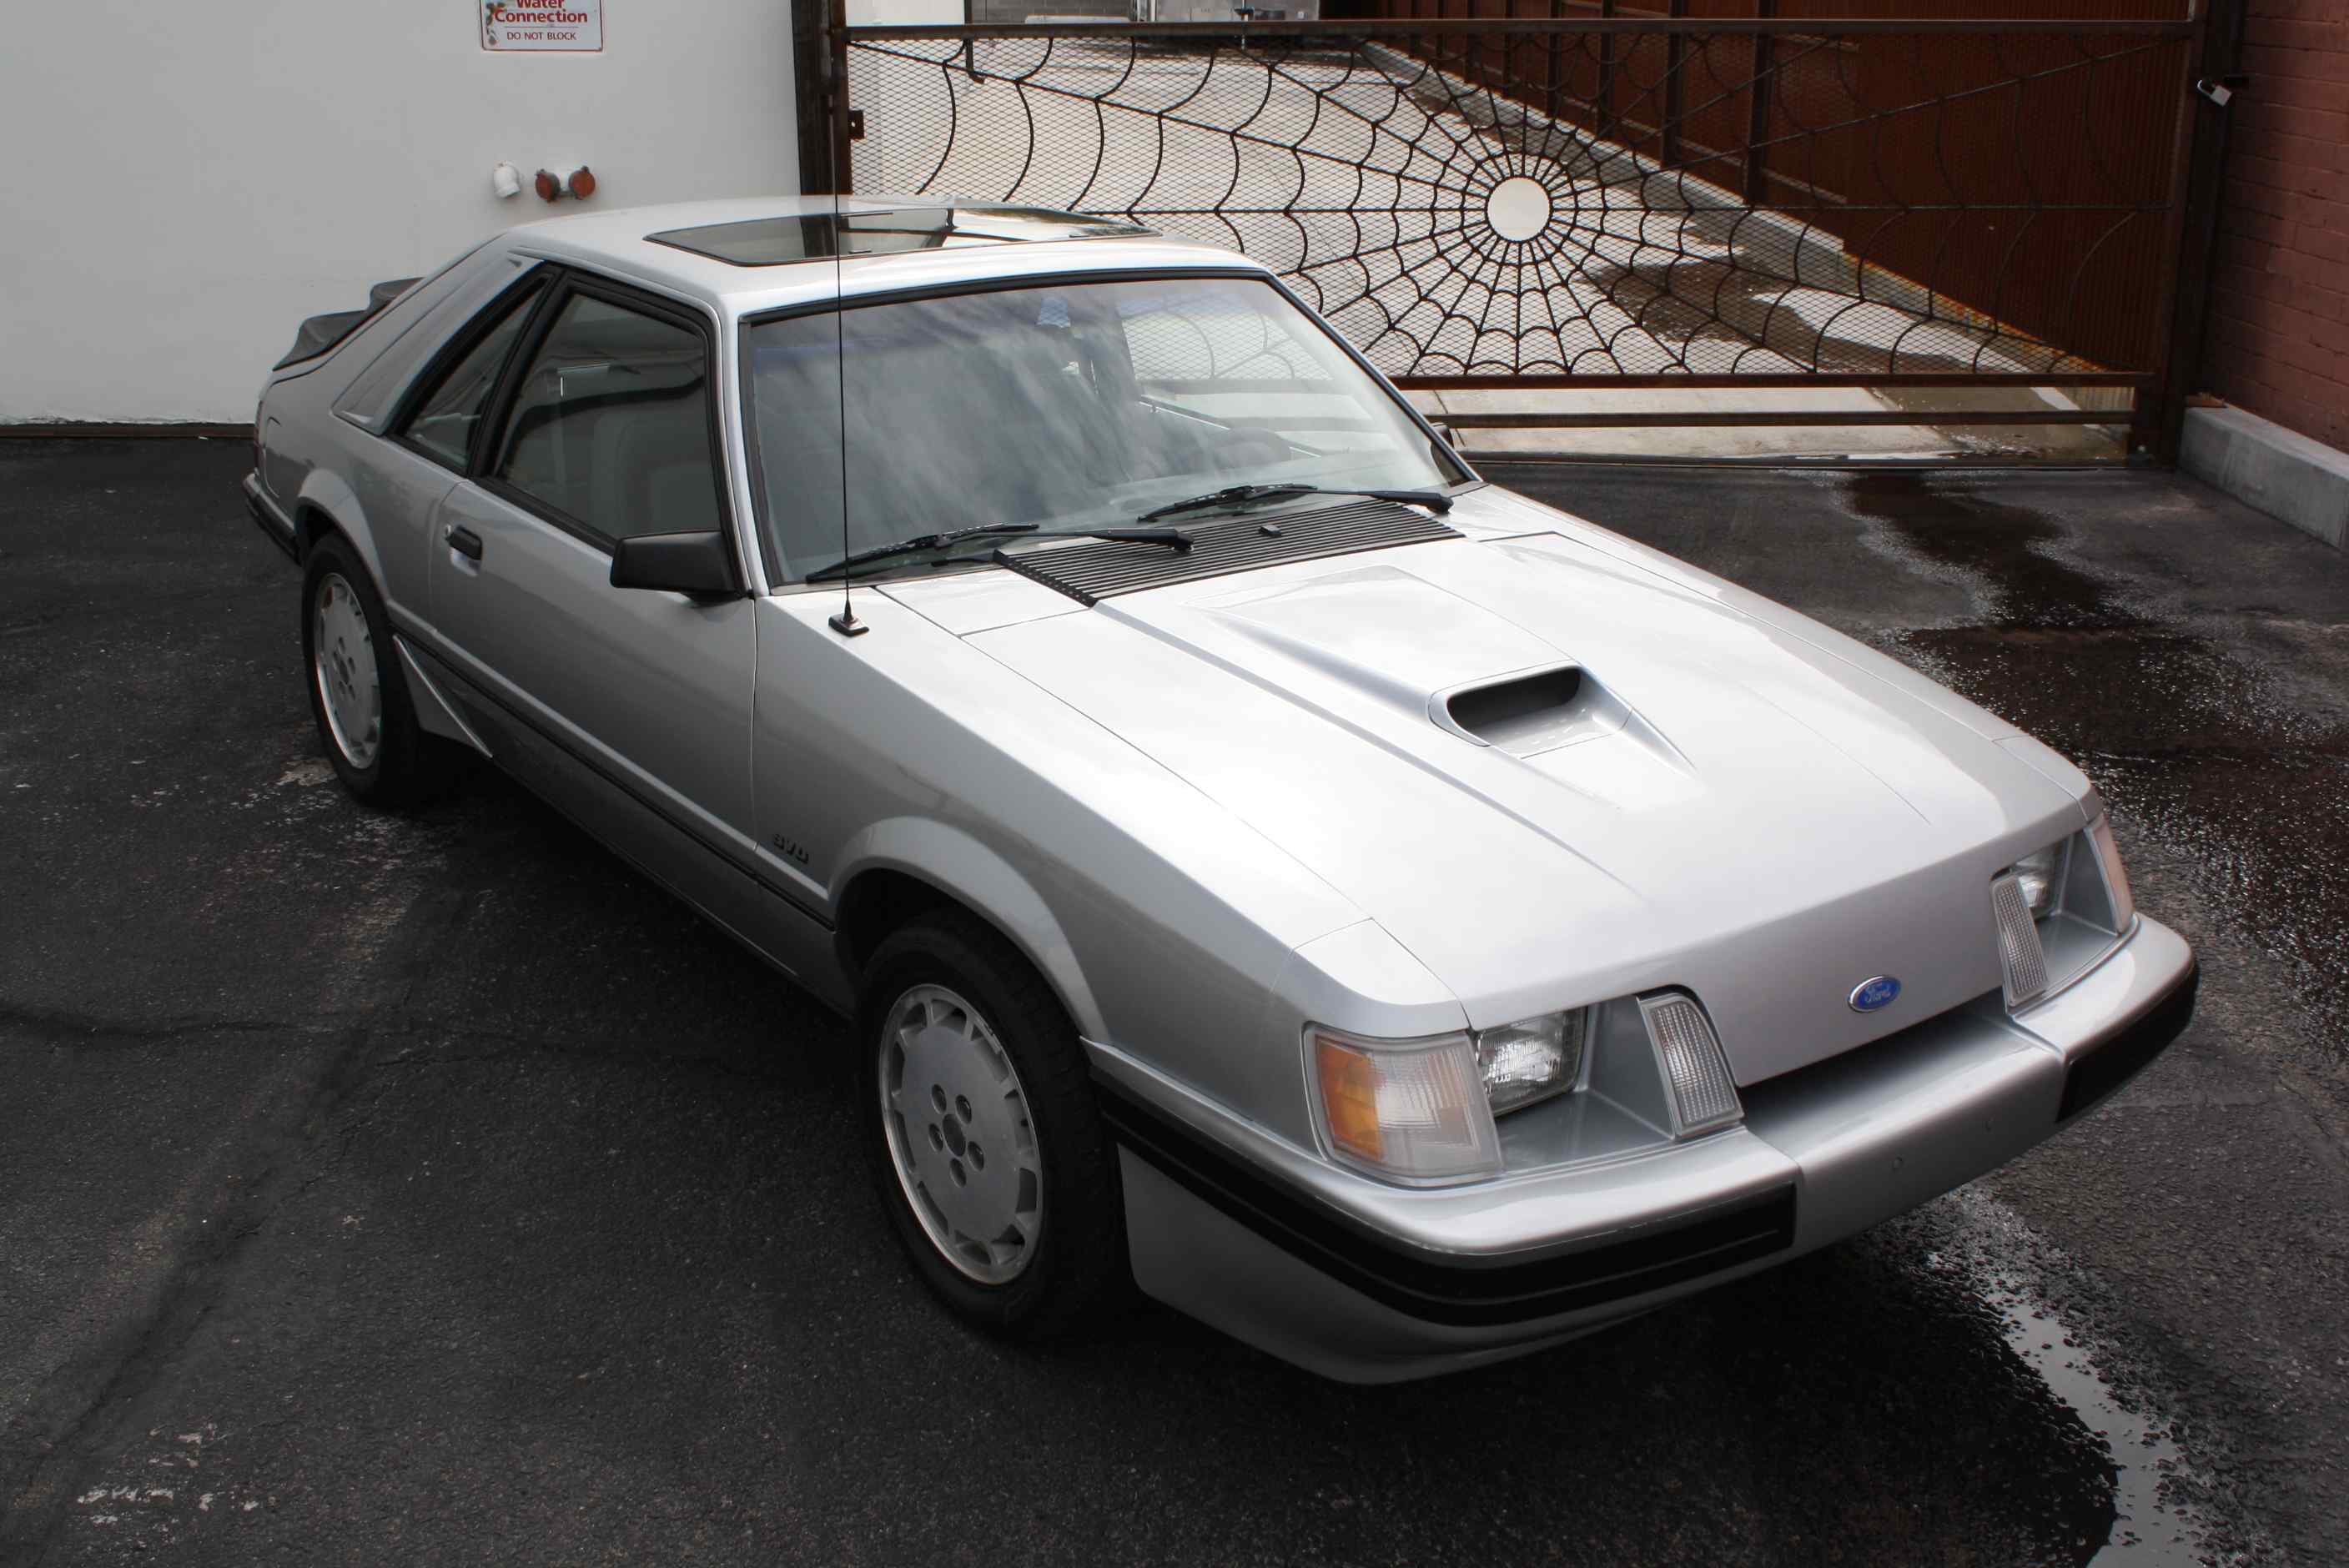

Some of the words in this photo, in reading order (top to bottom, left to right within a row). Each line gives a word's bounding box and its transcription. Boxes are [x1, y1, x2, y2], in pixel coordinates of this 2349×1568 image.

[516, 0, 565, 8] Water
[495, 8, 588, 23] Connection
[506, 32, 521, 40] DO
[525, 32, 543, 40] NOT
[547, 32, 576, 40] BLOCK
[1863, 983, 1892, 1003] Ford
